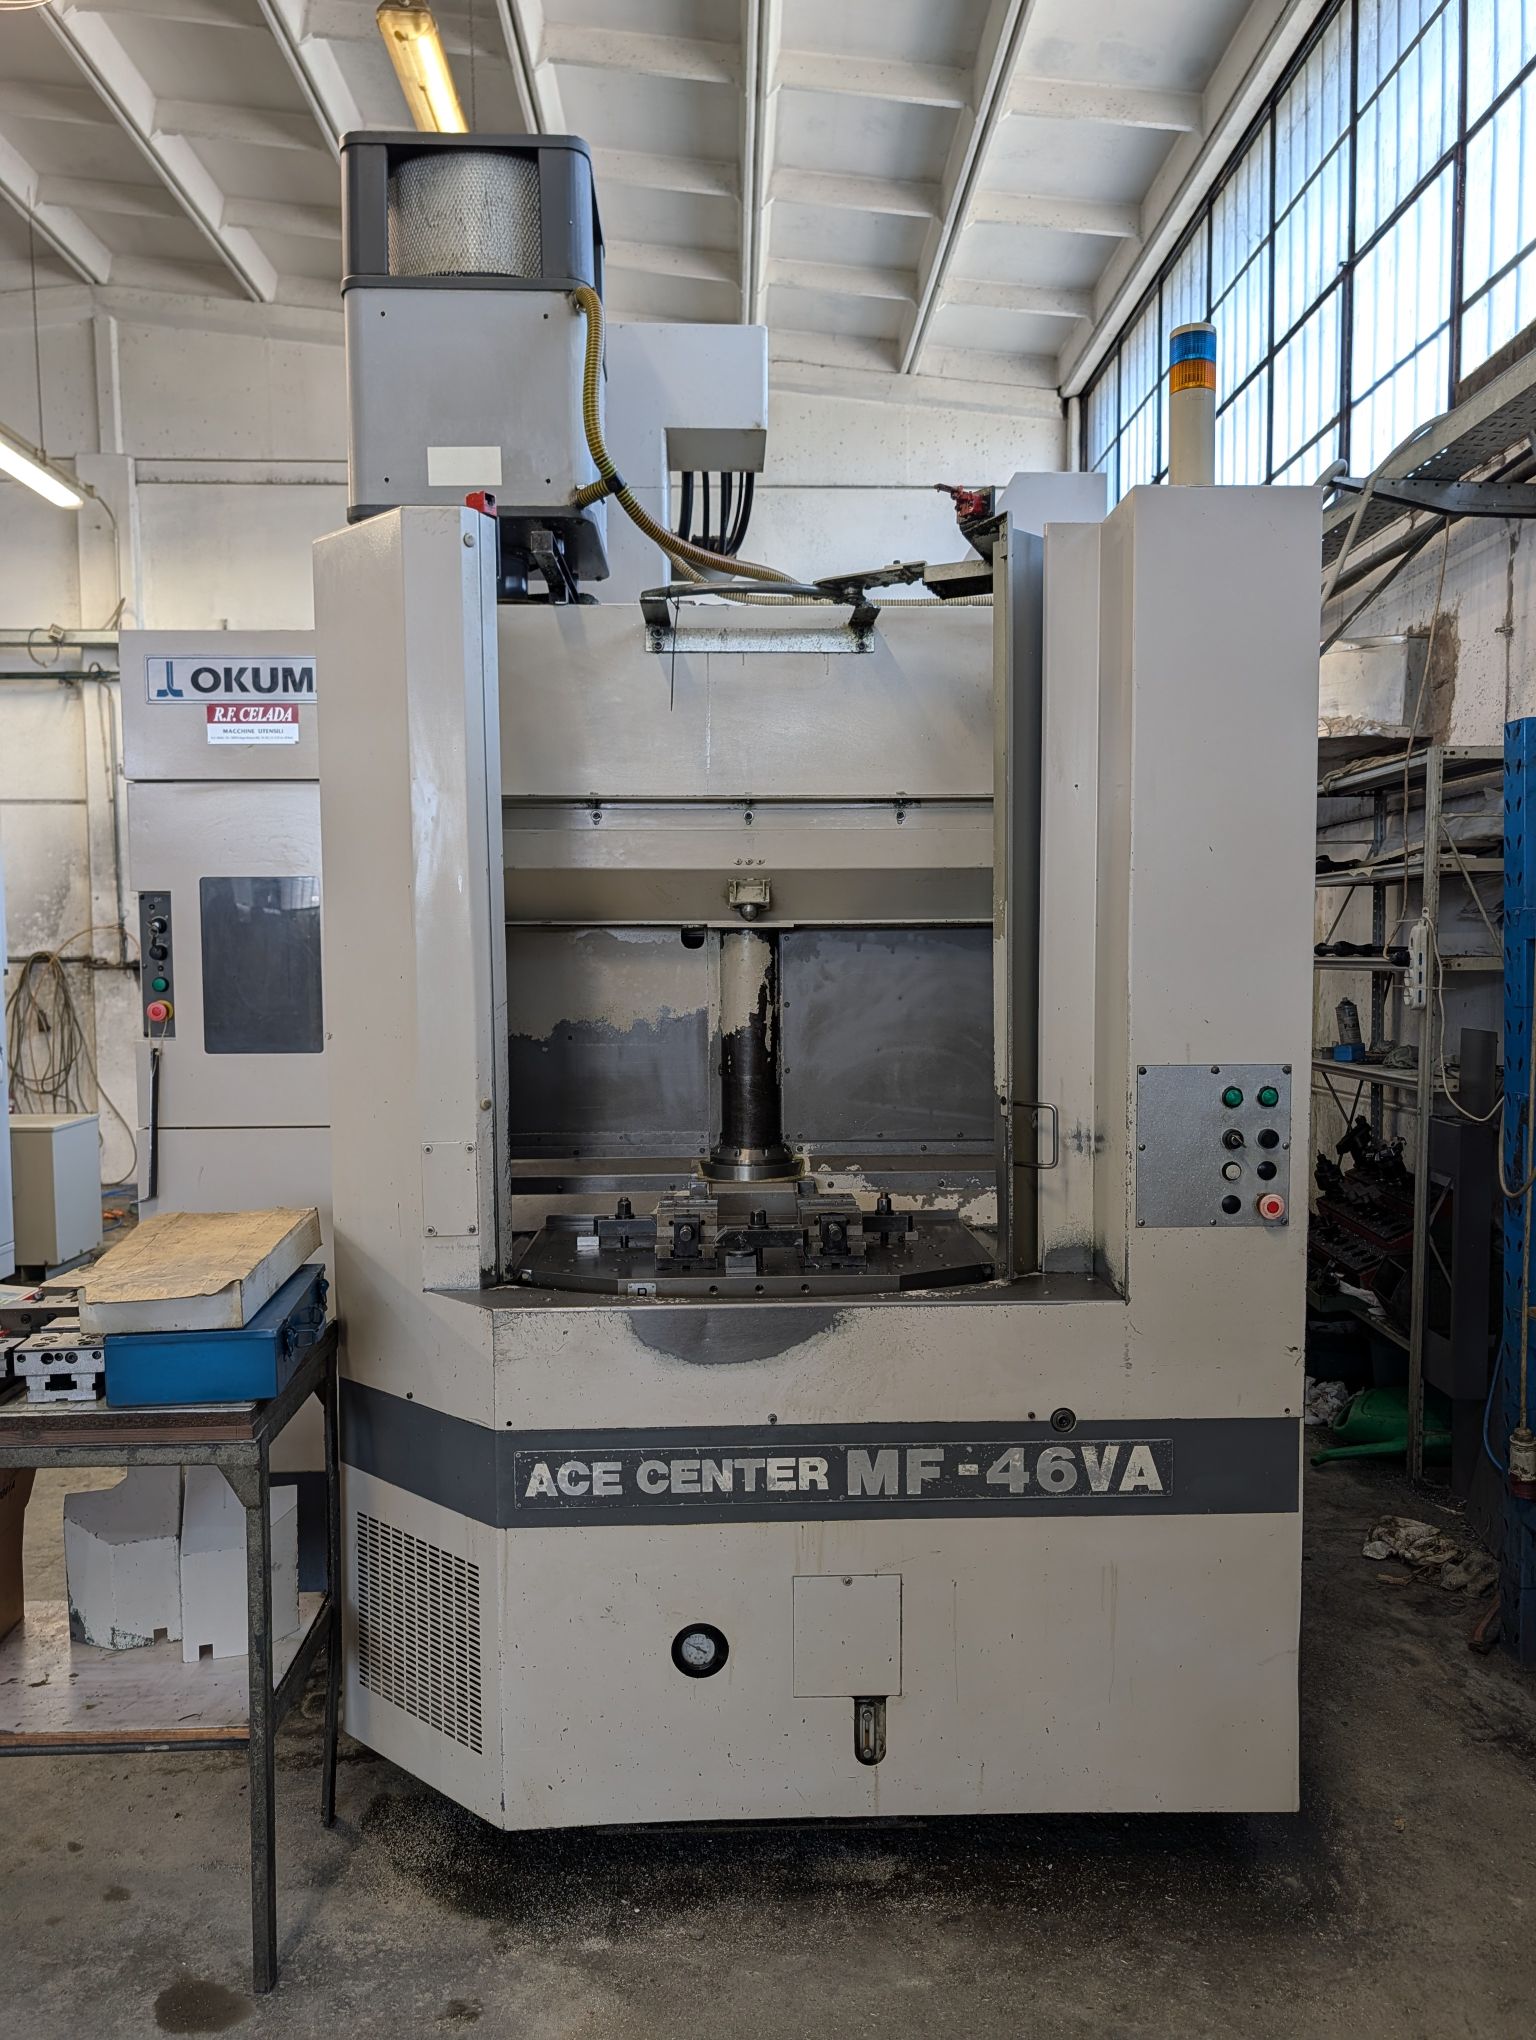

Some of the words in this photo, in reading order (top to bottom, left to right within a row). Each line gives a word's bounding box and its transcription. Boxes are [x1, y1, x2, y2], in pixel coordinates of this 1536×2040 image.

[190, 667, 317, 694] OKUM
[213, 707, 236, 722] R.F.
[239, 707, 293, 722] CELADA
[525, 1460, 623, 1497] ACE
[636, 1456, 829, 1495] CENTER
